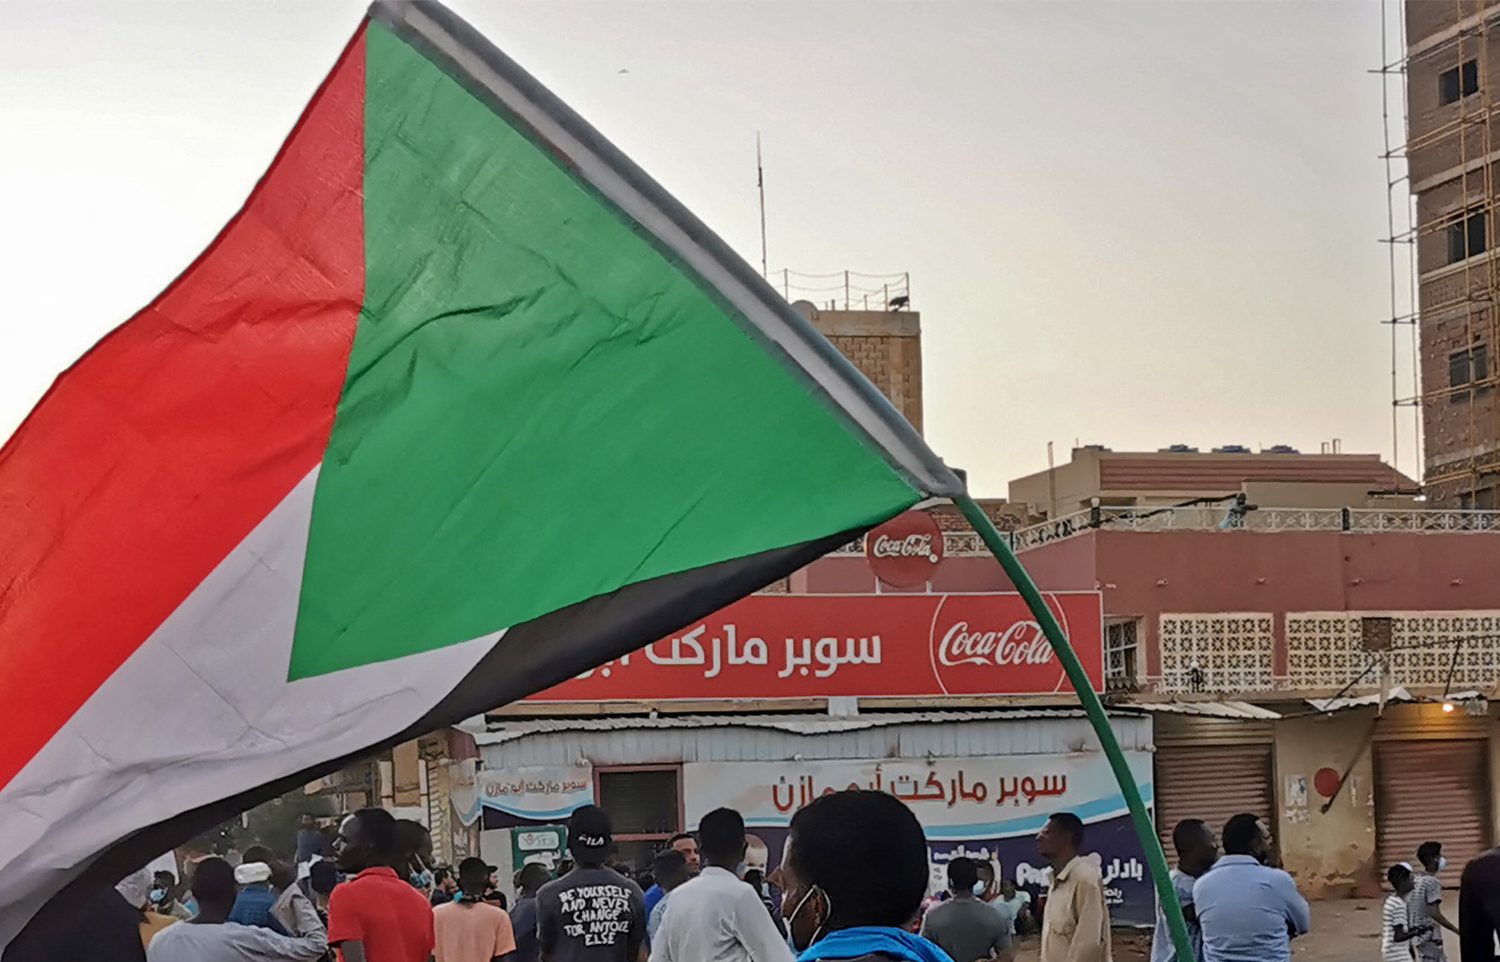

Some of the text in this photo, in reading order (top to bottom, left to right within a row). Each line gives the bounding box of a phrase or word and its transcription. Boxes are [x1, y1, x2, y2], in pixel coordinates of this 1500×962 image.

[873, 534, 932, 558] Coca-Cola
[938, 619, 1055, 667] Coca-Cola
[778, 635, 882, 679] سوبر
[889, 769, 988, 809] ماركت
[996, 773, 1067, 807] سوبر
[559, 885, 633, 902] BE YOURSELF
[561, 897, 631, 914] AND NEVER
[573, 909, 622, 923] CHANGE
[585, 933, 617, 947] ELSE
